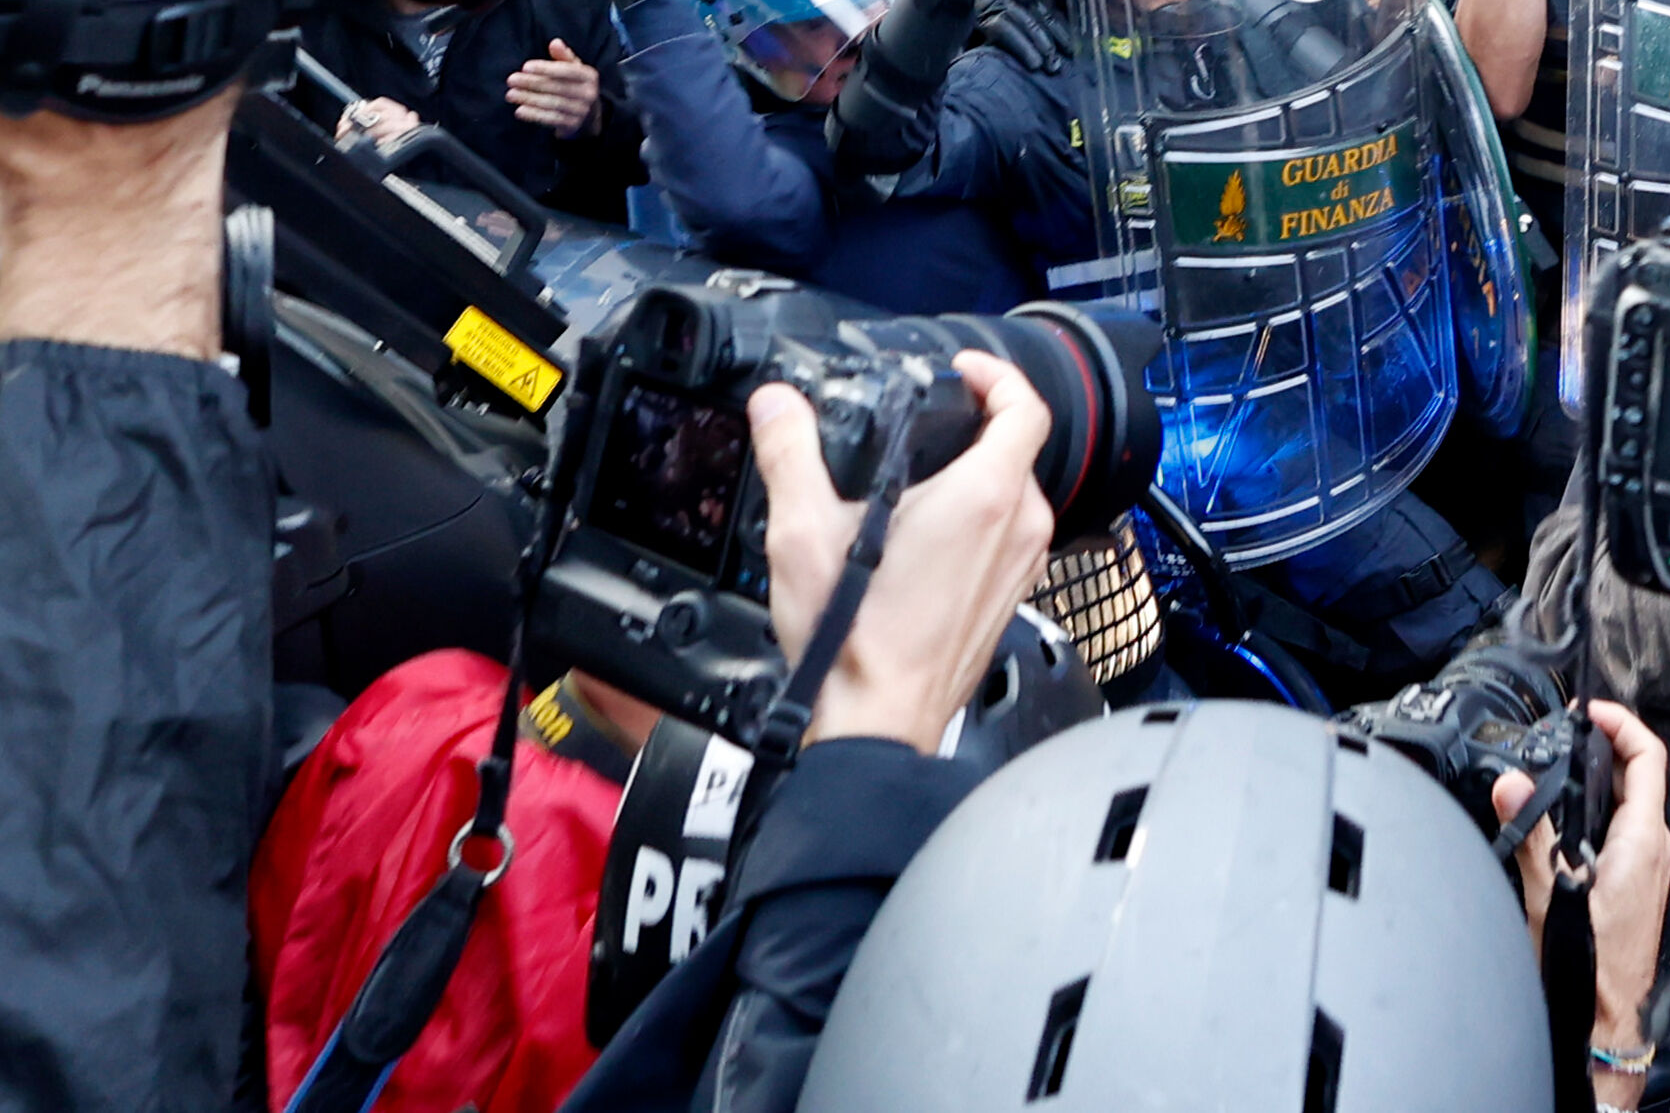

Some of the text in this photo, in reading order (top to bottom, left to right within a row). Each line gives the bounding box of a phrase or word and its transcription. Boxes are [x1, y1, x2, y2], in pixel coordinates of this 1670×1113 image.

[1281, 133, 1399, 187] GUARDIA
[1279, 185, 1396, 240] FINANZA
[1330, 178, 1350, 202] di
